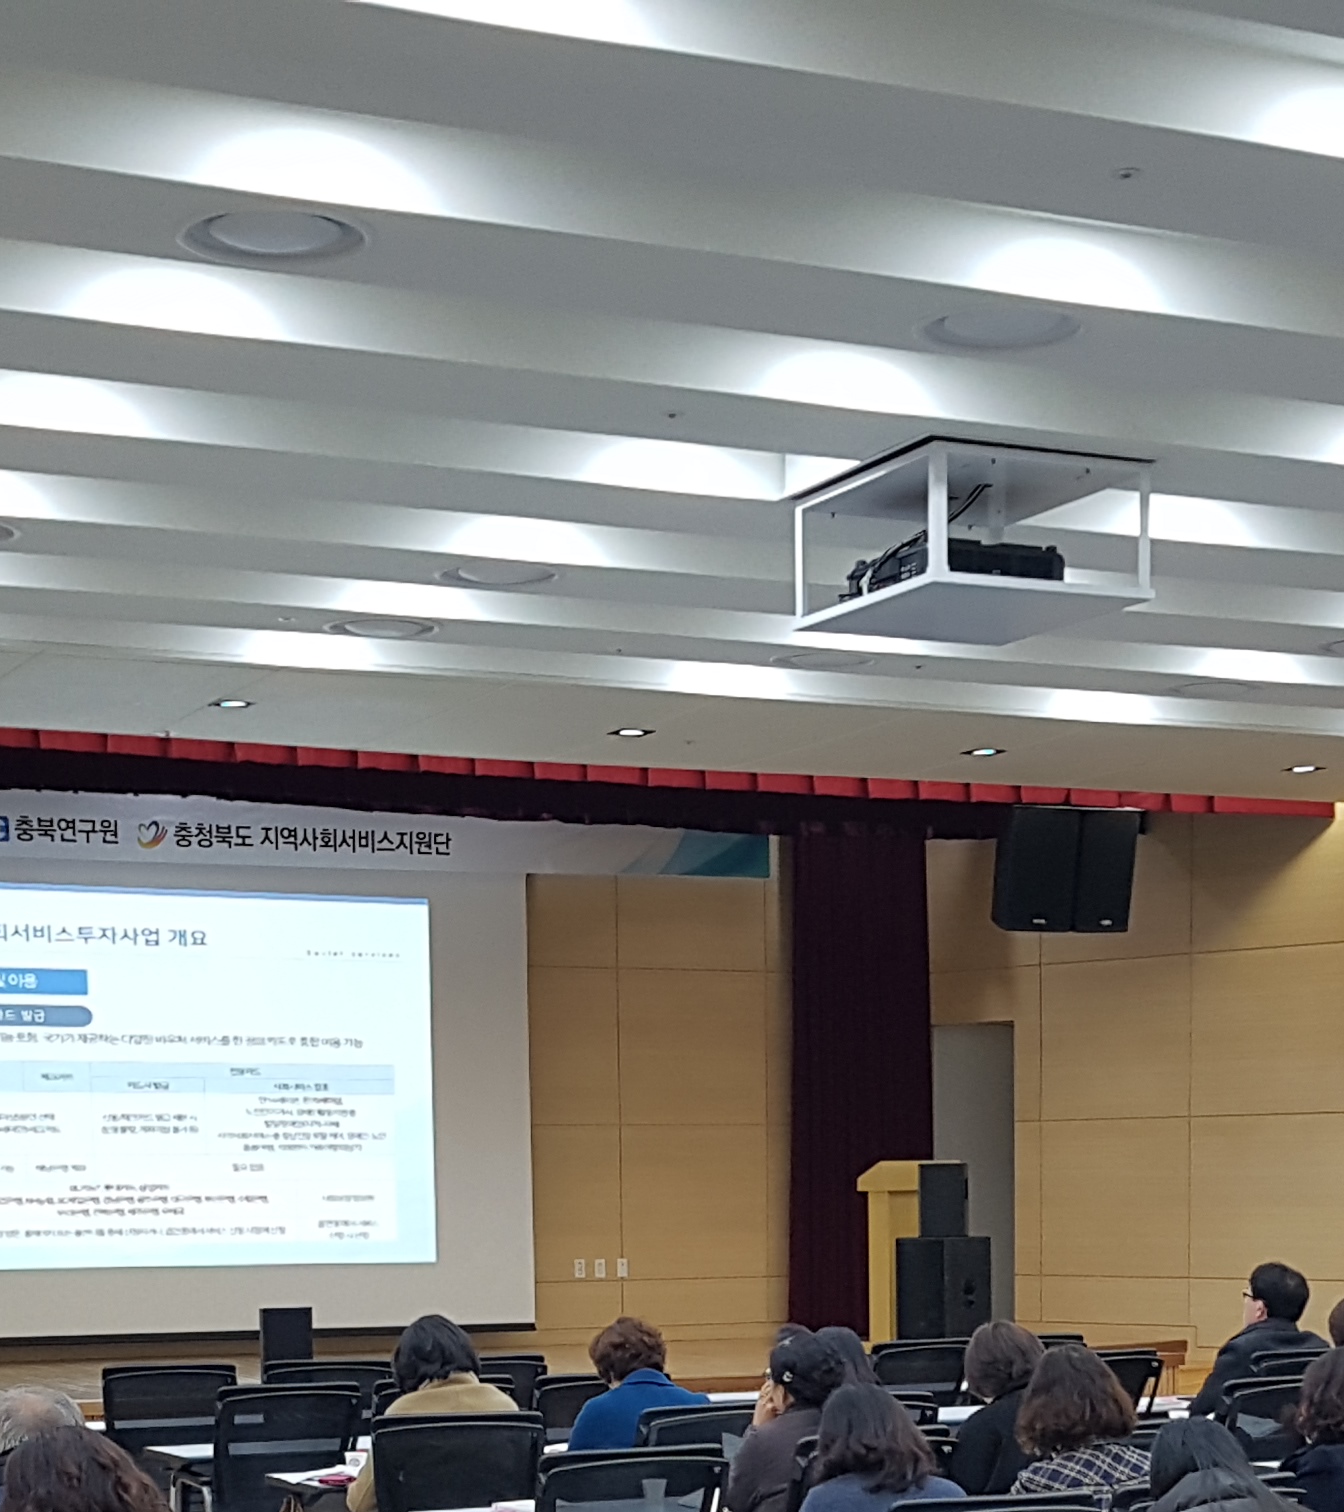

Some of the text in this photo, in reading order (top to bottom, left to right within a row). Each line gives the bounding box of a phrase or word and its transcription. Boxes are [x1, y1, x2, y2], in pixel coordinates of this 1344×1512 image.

[14, 816, 119, 844] 충북연구원
[173, 823, 452, 856] 충청북도 지역사회서비스지원단
[167, 928, 209, 947] 개요
